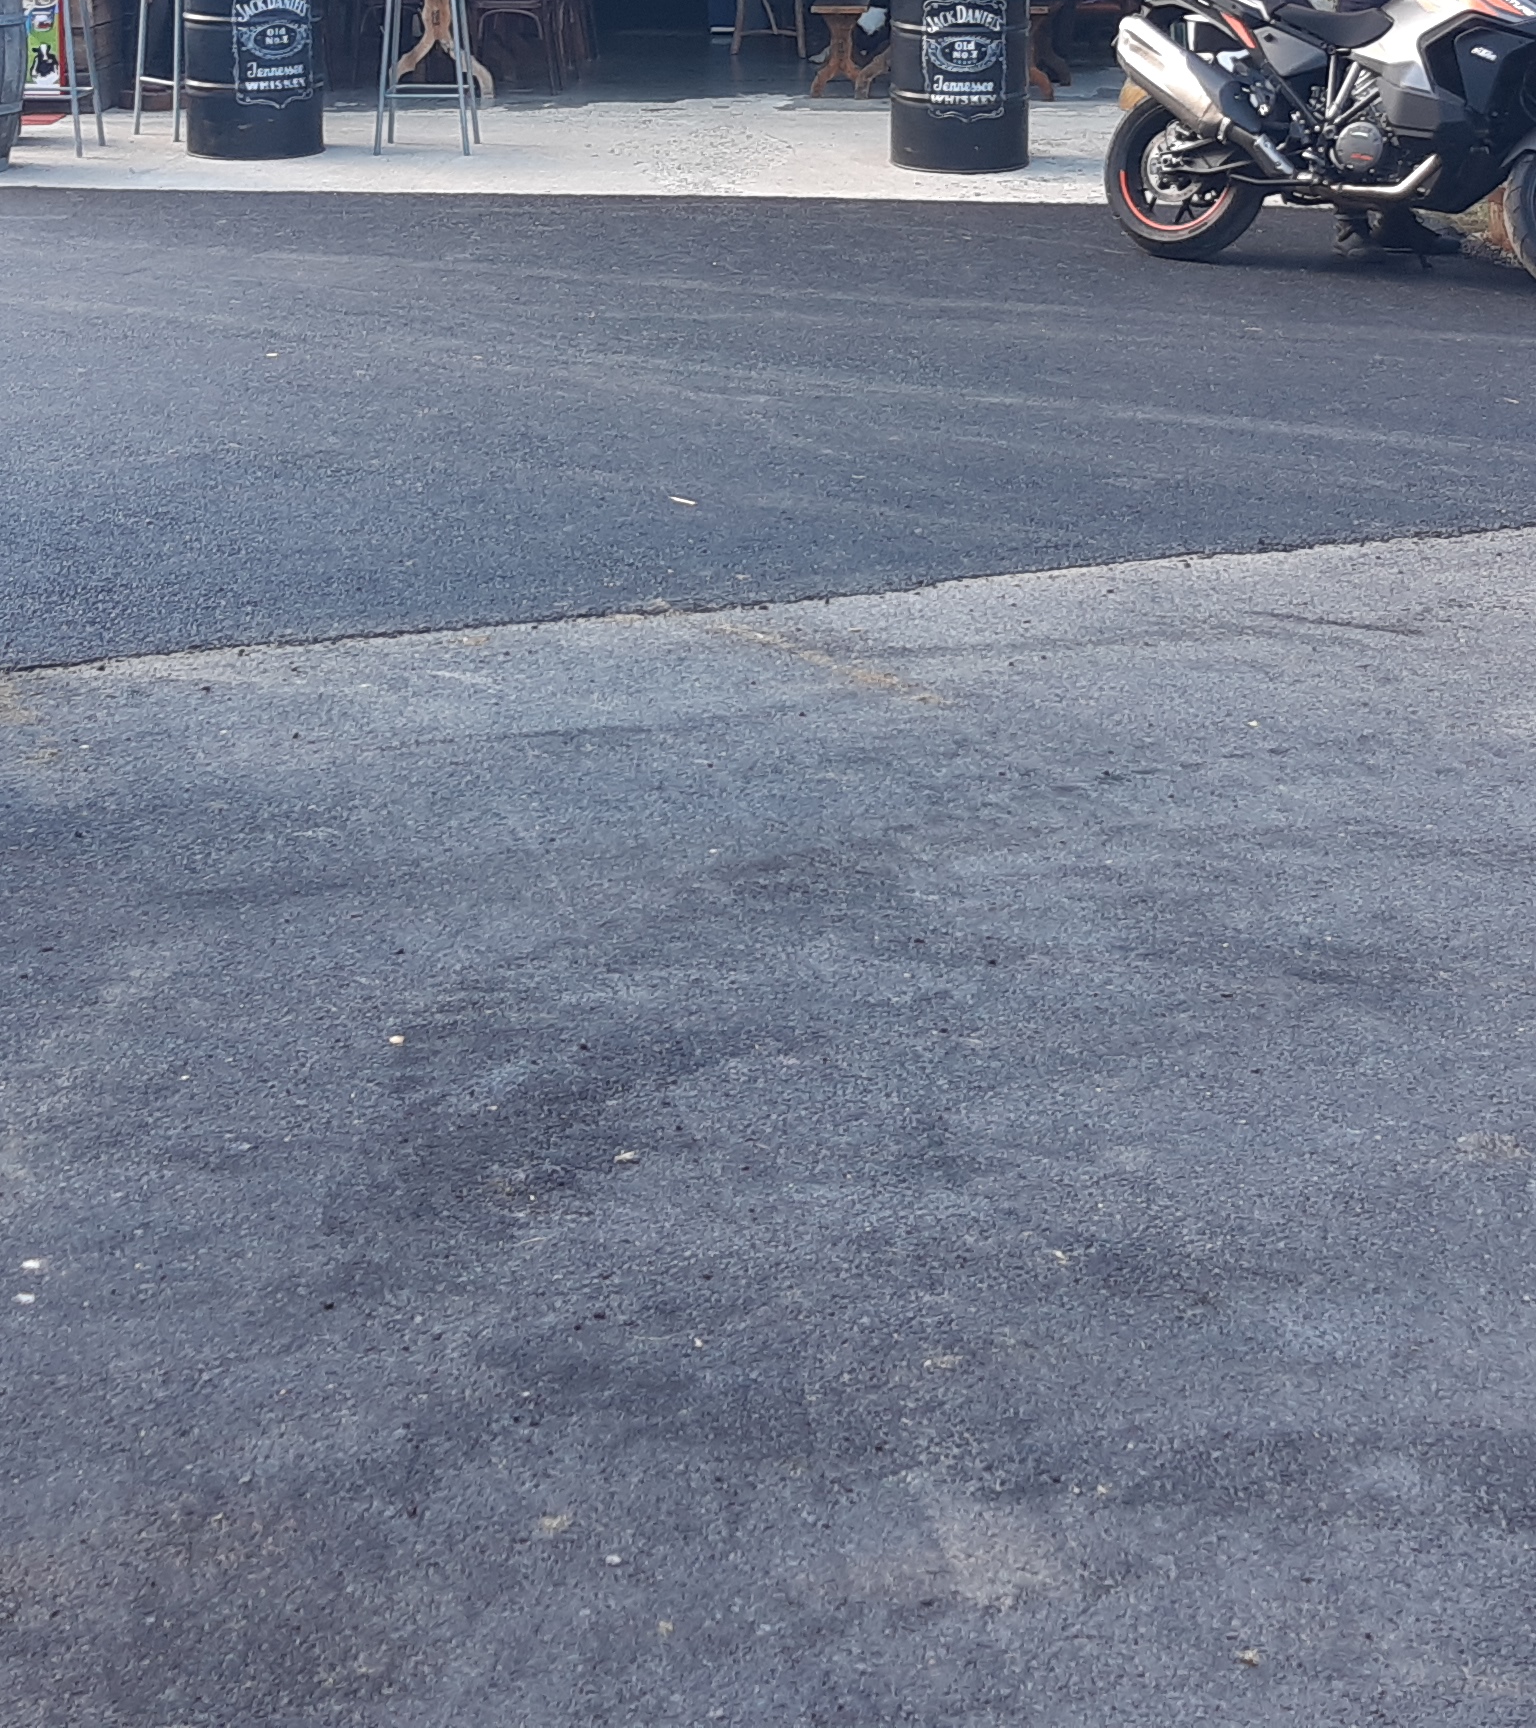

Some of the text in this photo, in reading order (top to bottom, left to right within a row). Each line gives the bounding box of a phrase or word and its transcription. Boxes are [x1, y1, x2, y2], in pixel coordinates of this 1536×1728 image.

[926, 9, 956, 33] JACK
[246, 62, 304, 78] Tennessee
[245, 78, 306, 91] WHISKEY
[933, 75, 994, 92] Tennessee
[930, 93, 997, 105] WHISKEY
